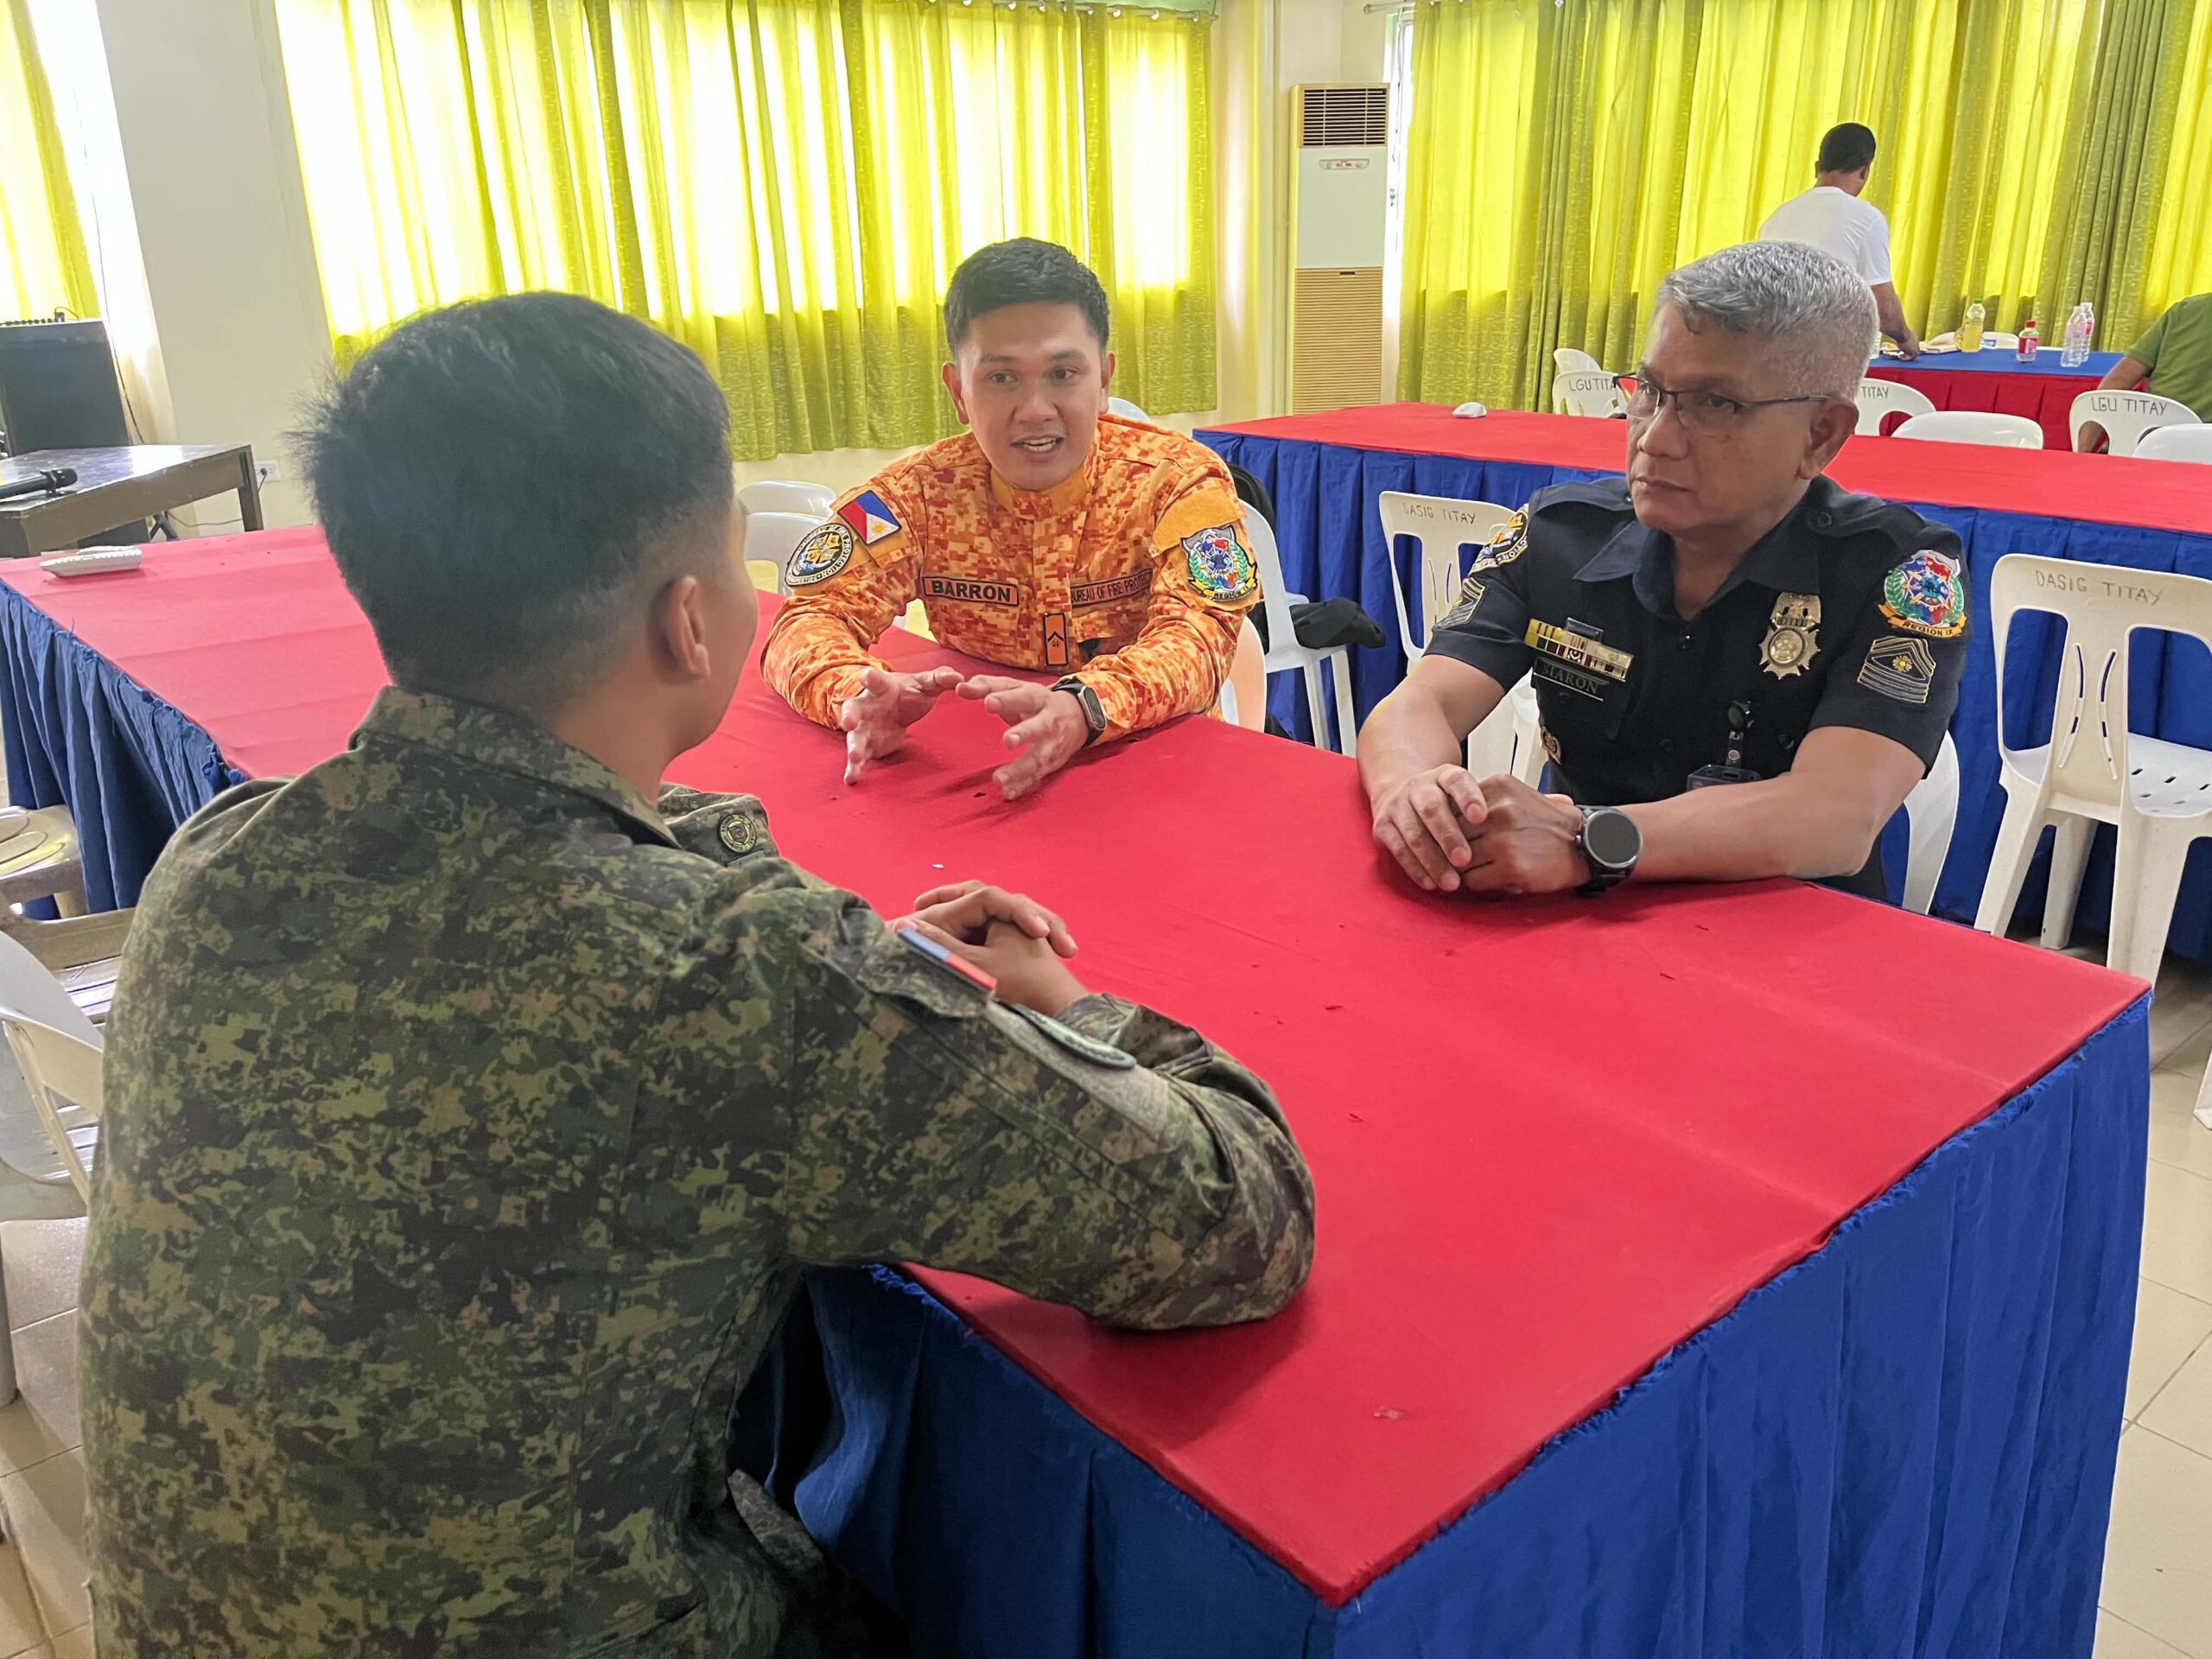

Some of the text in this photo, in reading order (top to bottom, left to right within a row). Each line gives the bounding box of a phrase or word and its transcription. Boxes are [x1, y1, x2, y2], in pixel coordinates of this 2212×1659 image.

[1568, 378, 1592, 391] LGU
[1860, 386, 1889, 399] TITAY
[2091, 396, 2168, 416] LGU TITAY
[1442, 507, 1477, 524] TITAY
[931, 580, 1011, 602] BARRON
[1071, 587, 1096, 603] BUREAU
[1096, 585, 1105, 599] OF
[1108, 581, 1123, 596] FIRE
[2035, 569, 2164, 607] DASIG TITAY
[1902, 620, 1943, 637] REGION
